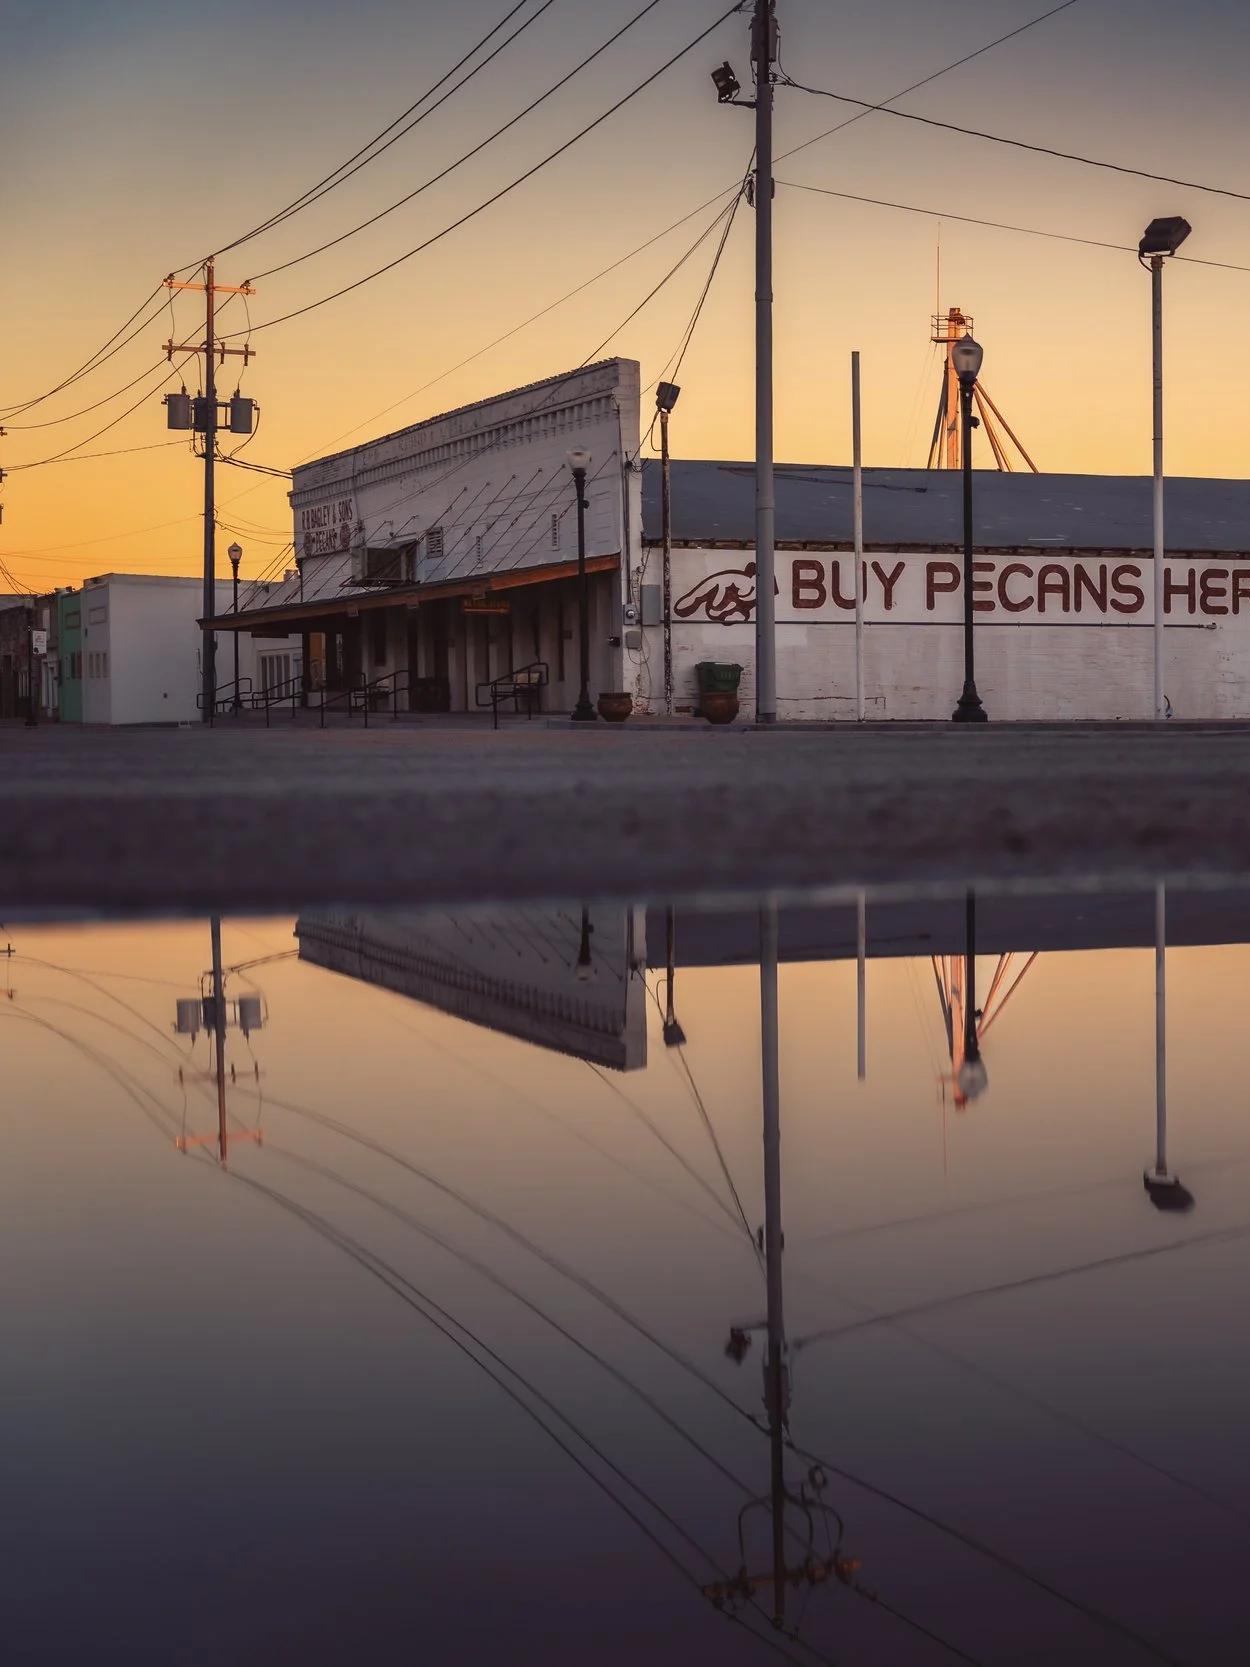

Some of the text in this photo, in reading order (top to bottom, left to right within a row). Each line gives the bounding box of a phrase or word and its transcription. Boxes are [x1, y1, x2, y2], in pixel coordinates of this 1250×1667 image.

[338, 498, 353, 523] SONS
[792, 559, 906, 611] BUY
[926, 561, 1145, 614] PECANS
